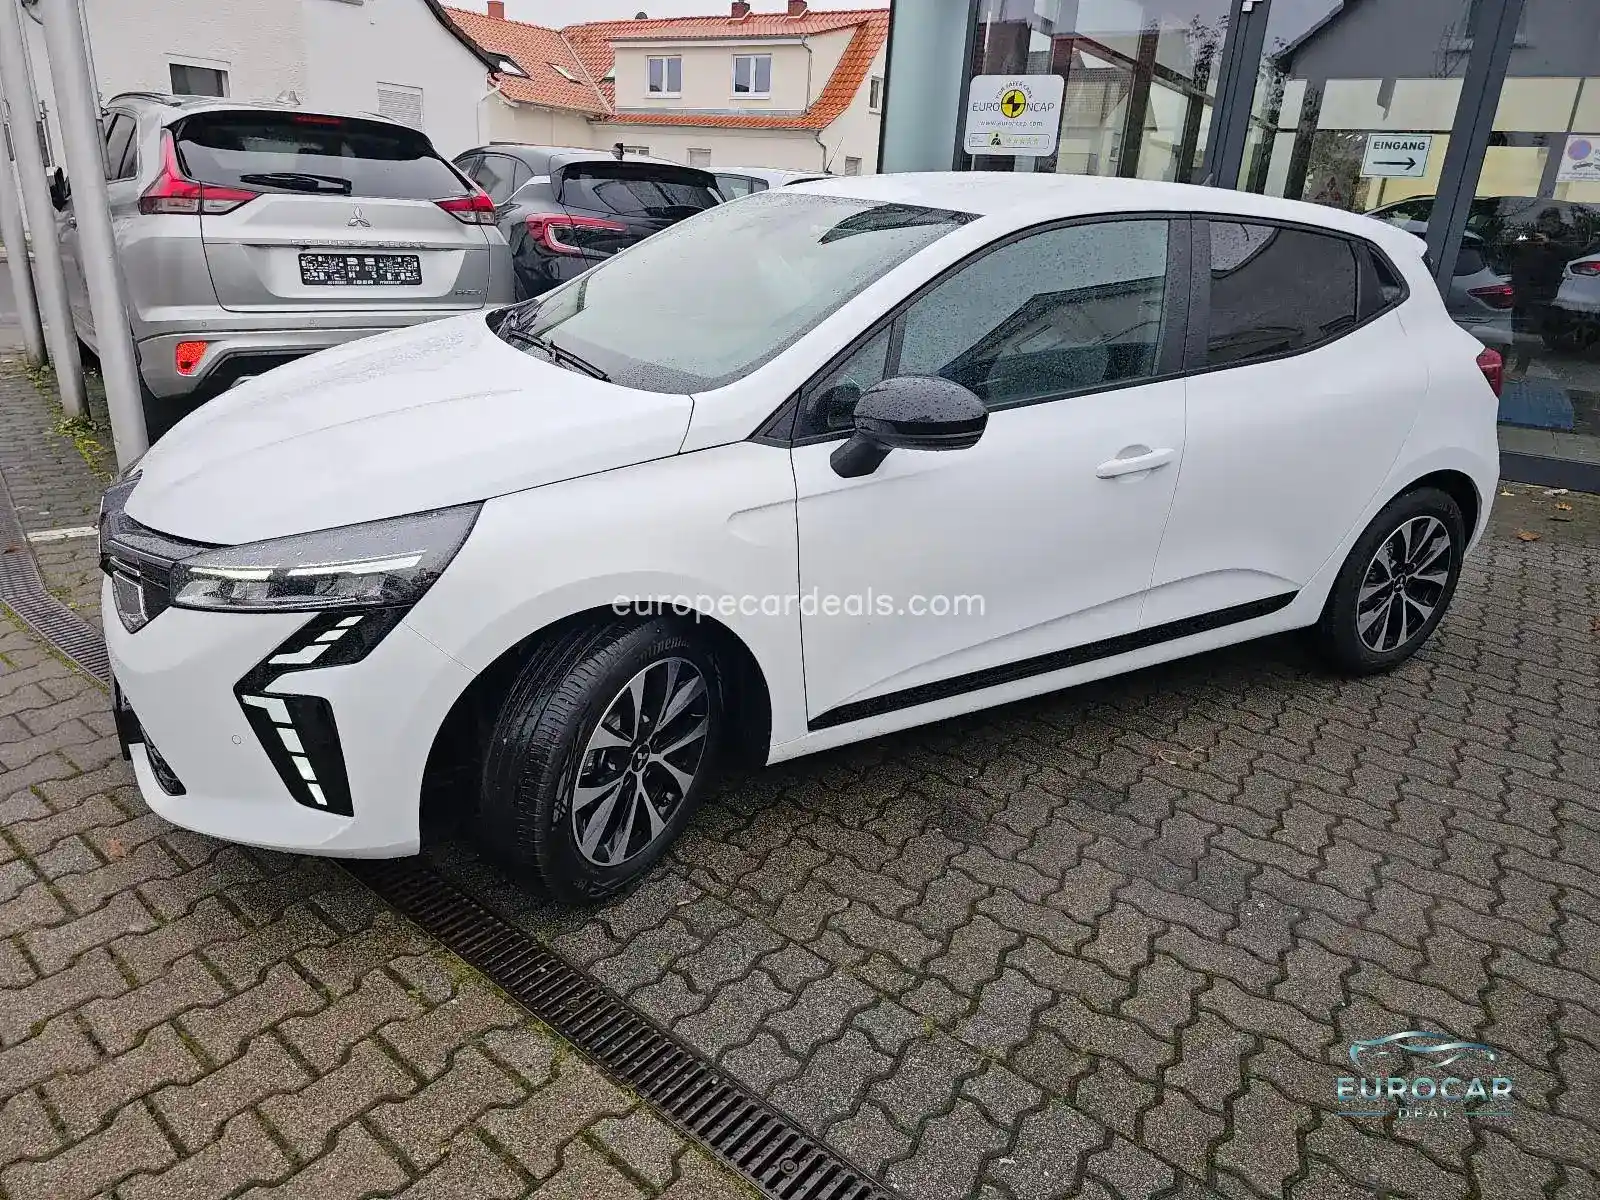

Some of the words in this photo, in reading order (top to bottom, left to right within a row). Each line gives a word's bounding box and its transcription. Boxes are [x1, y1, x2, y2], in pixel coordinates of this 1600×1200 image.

[972, 102, 1000, 112] EURO
[1026, 102, 1055, 112] NCAP
[1373, 141, 1426, 151] EINGANG
